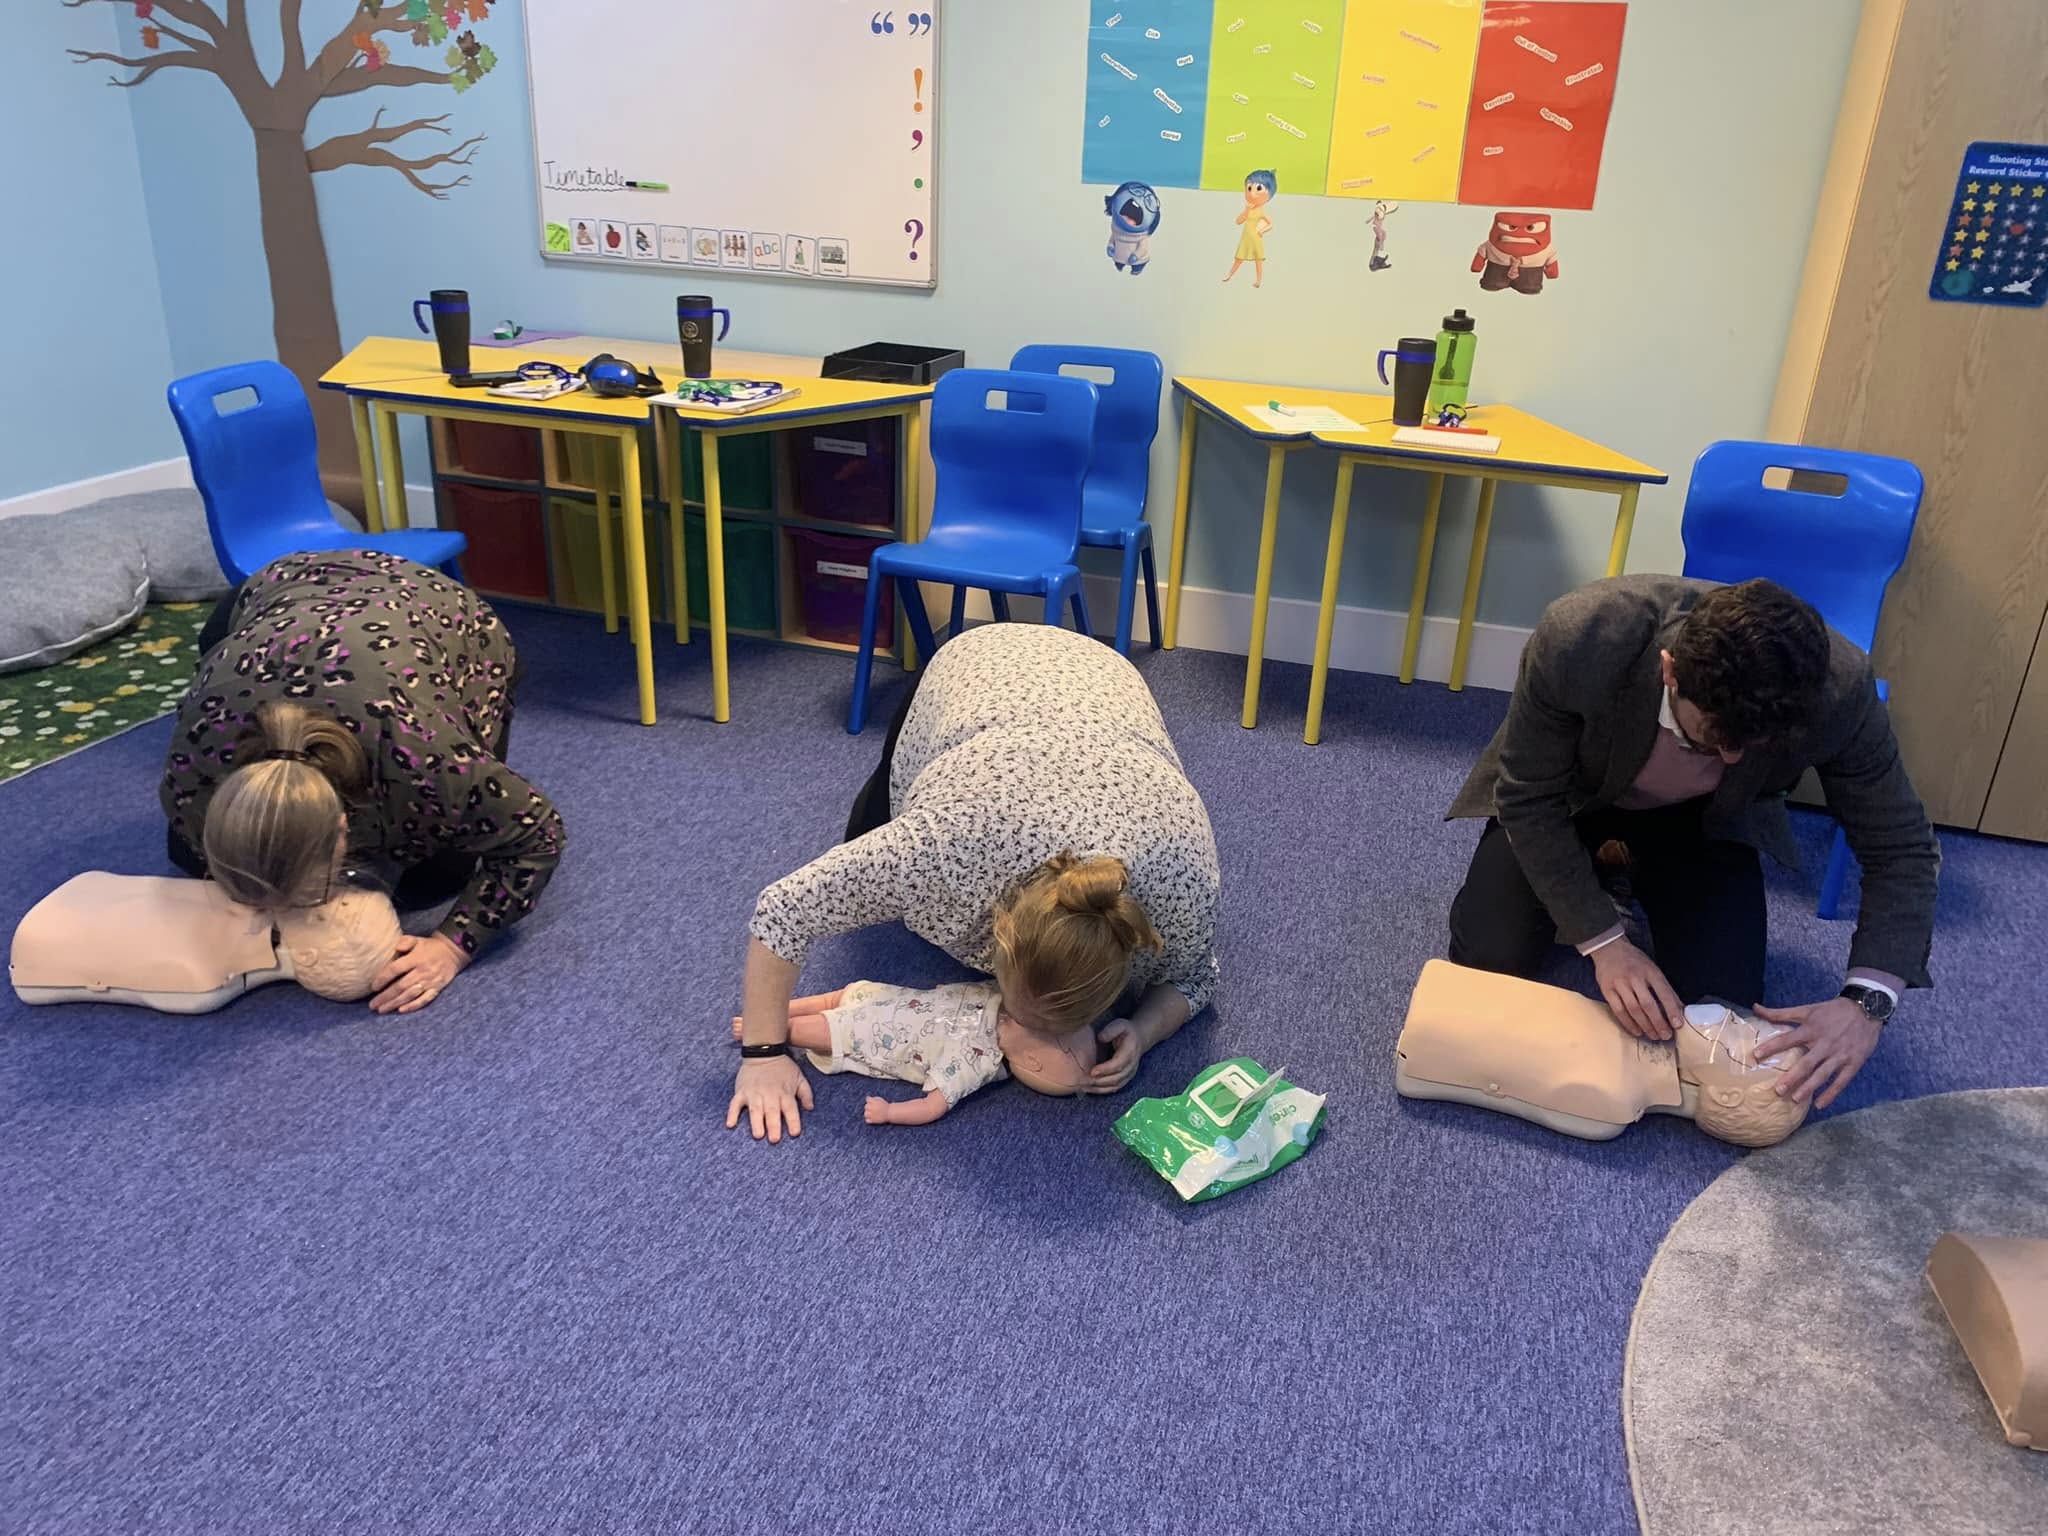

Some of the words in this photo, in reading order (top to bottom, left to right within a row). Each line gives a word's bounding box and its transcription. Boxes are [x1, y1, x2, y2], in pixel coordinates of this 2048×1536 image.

[1988, 154, 2032, 167] Shooting
[543, 160, 625, 188] Timetable
[1969, 166, 2006, 176] Reward
[2008, 168, 2042, 177] Sticker
[754, 239, 778, 257] abc
